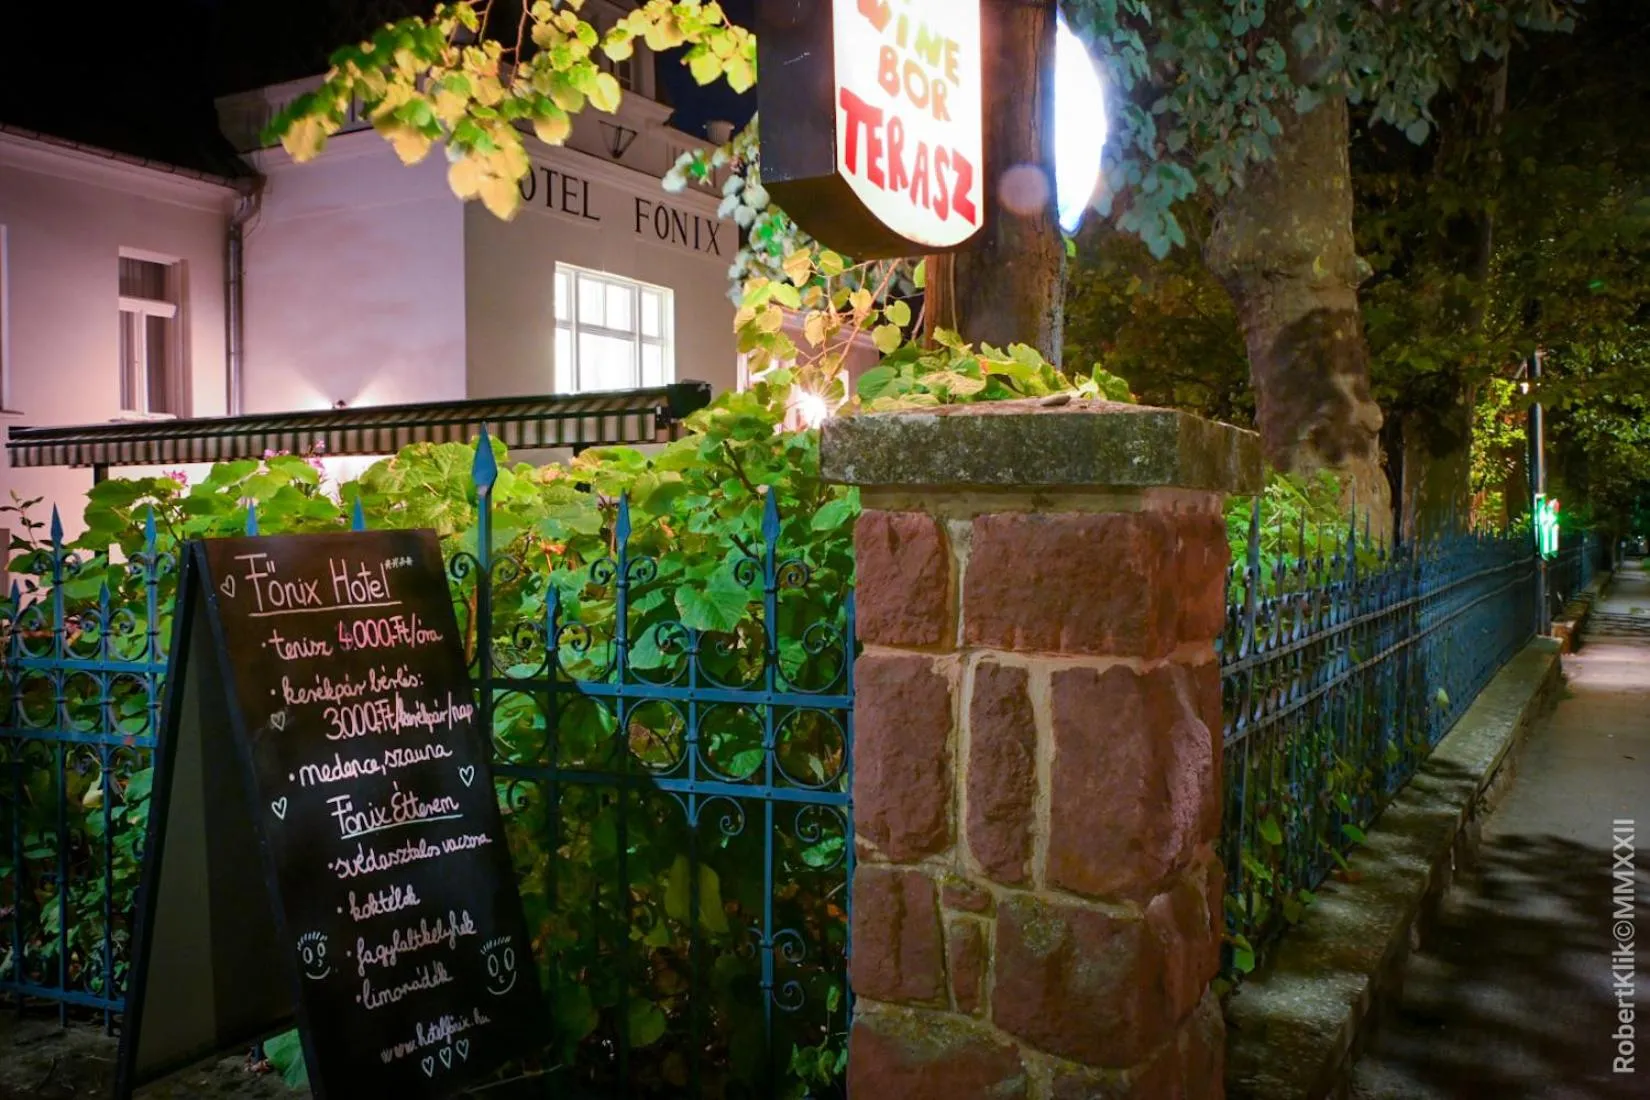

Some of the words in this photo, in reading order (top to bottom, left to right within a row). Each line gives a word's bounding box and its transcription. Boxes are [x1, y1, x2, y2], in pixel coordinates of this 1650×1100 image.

[878, 44, 952, 122] BOR
[840, 86, 976, 226] TERASZ
[516, 164, 600, 222] OTEL
[268, 628, 334, 660] tenisz
[282, 674, 366, 705] kerékpár
